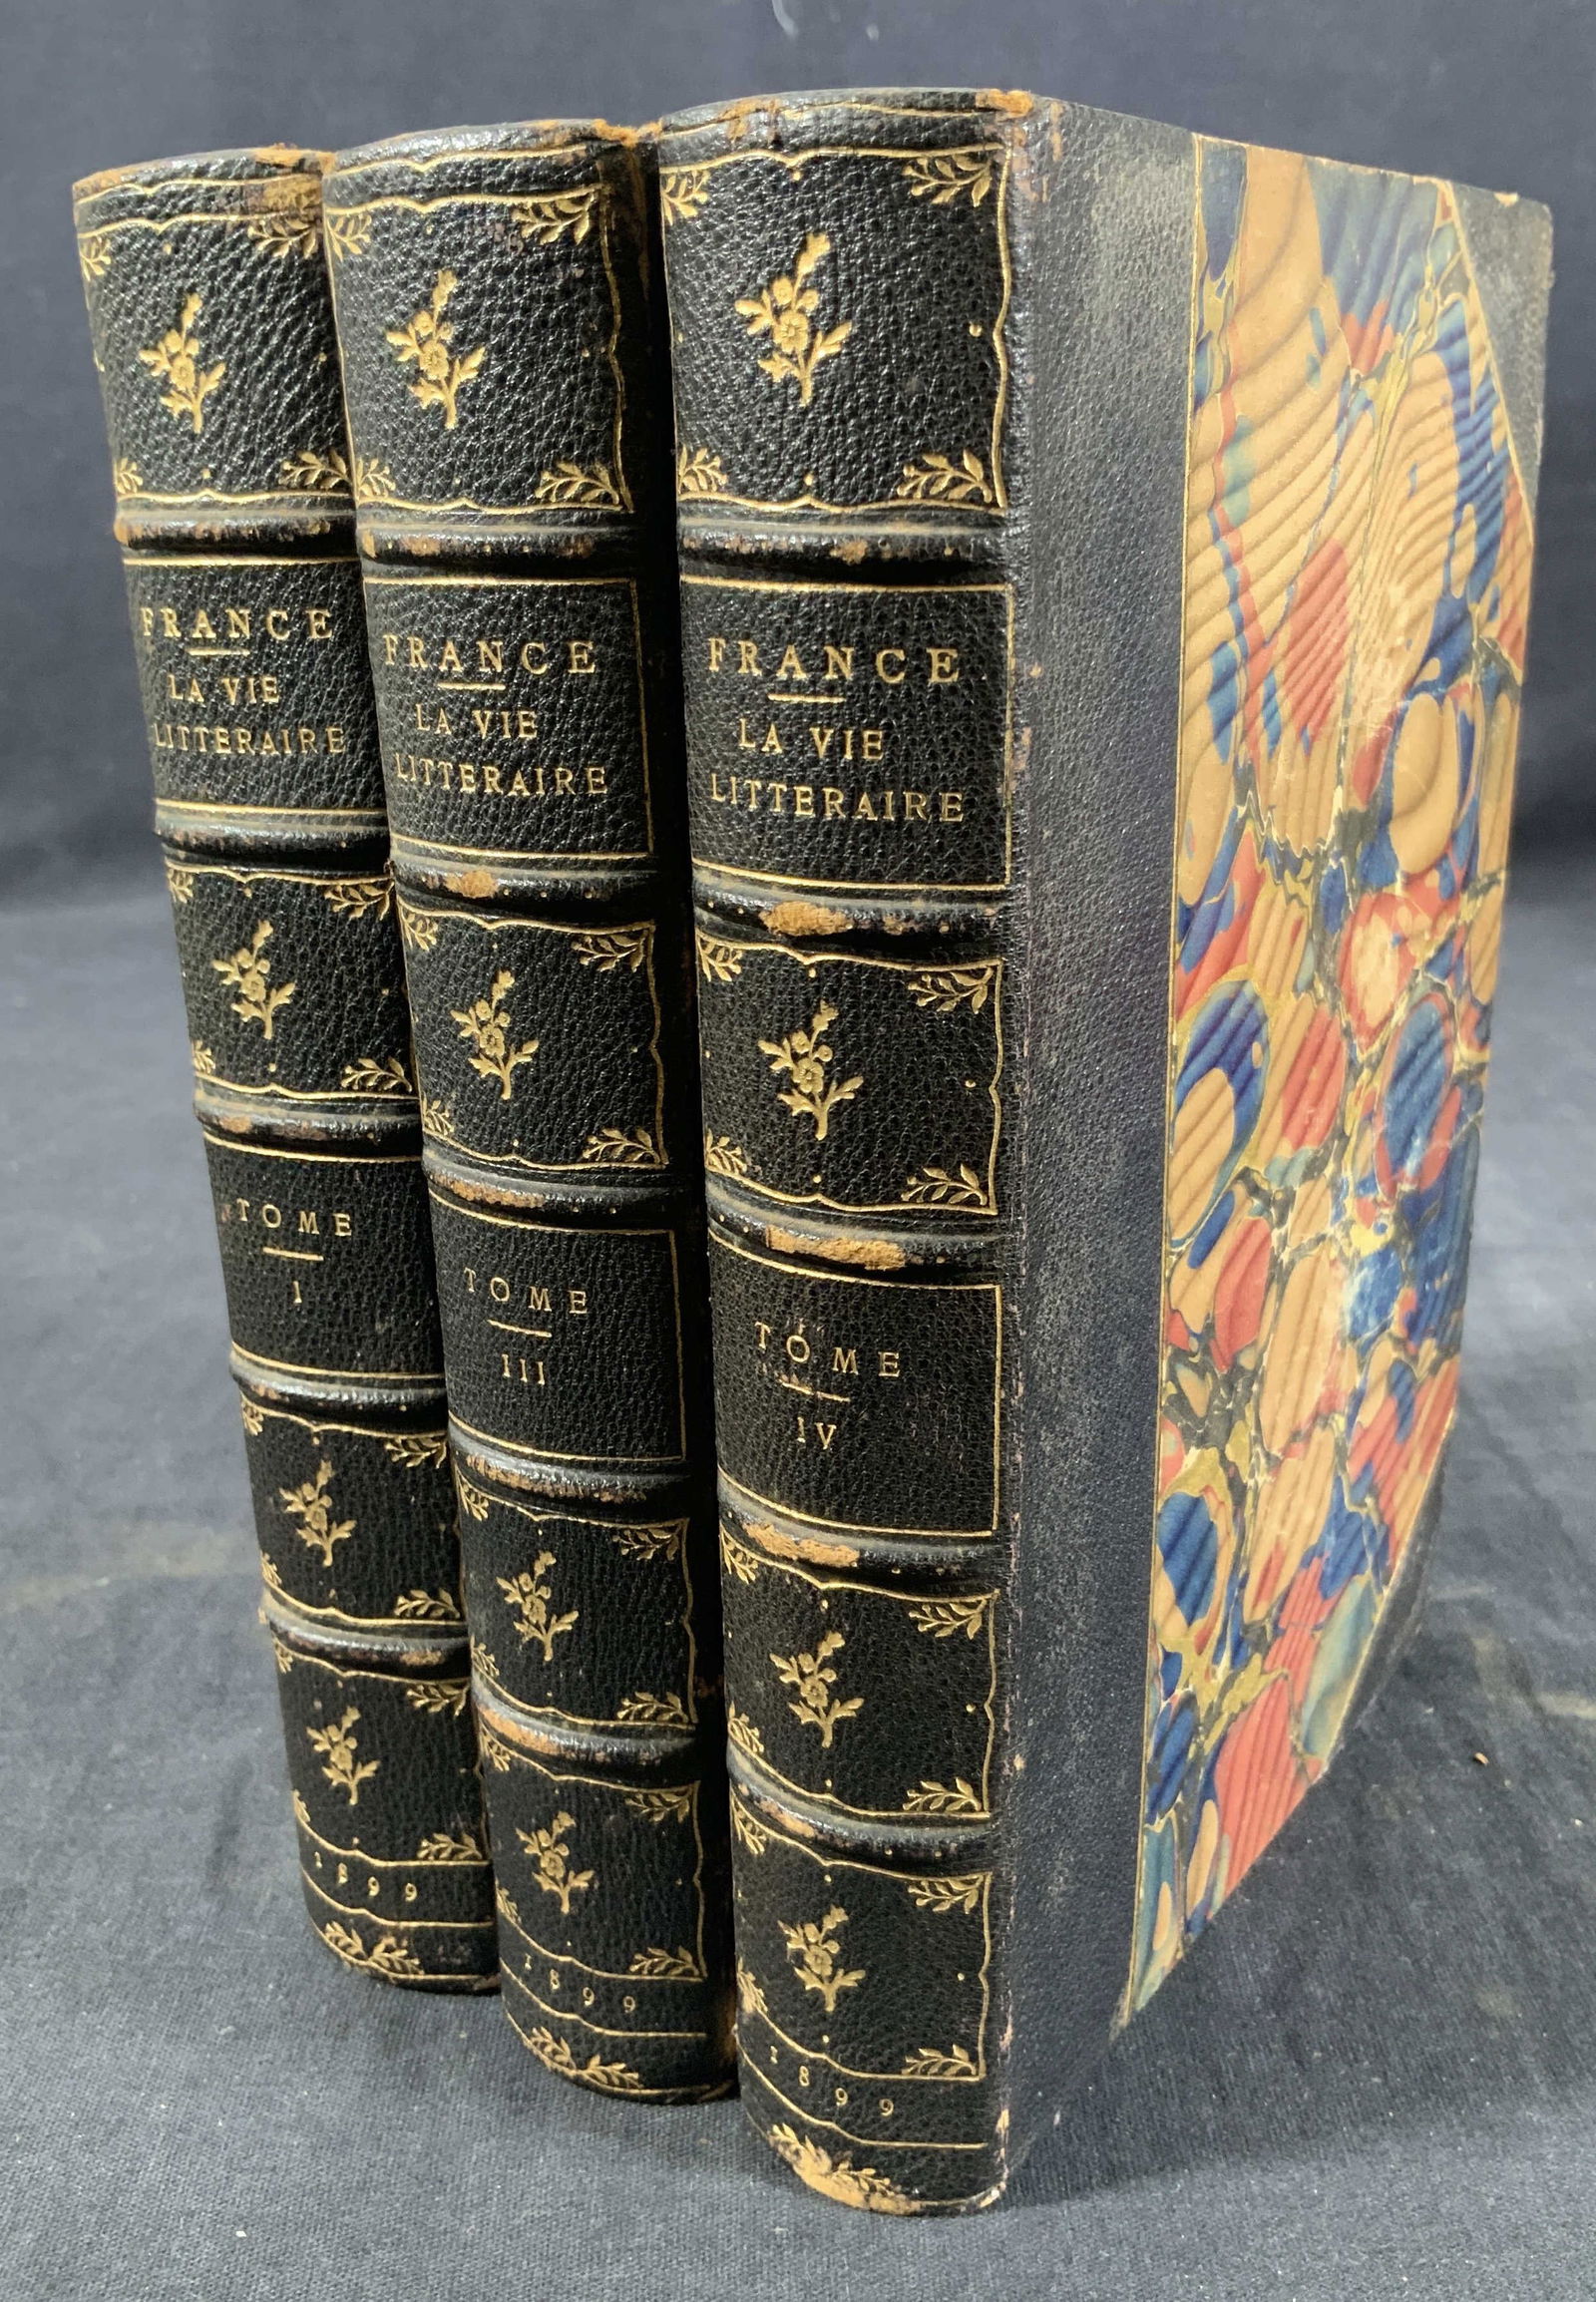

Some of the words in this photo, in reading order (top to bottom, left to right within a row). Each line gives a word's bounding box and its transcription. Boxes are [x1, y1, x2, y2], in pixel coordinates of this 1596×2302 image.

[140, 606, 333, 639] FRANCE
[383, 634, 597, 675] FRANCE
[708, 637, 960, 684] FRANCE
[167, 673, 204, 703] LA
[220, 675, 280, 705] VIE
[153, 721, 347, 756] LITTERAIRE
[415, 703, 452, 735] LA
[472, 709, 538, 739] VIE
[738, 717, 783, 755] LA
[809, 727, 885, 761] VIE
[395, 752, 608, 797] LITTERAIRE
[710, 773, 966, 823] LITTERAIRE
[235, 1197, 353, 1237] TOME
[463, 1267, 589, 1315] TOME
[501, 1353, 546, 1386] III
[754, 1321, 901, 1377] TOME
[796, 1416, 838, 1450] IV
[524, 1953, 637, 2015] 1899
[769, 2045, 895, 2117] 1899
